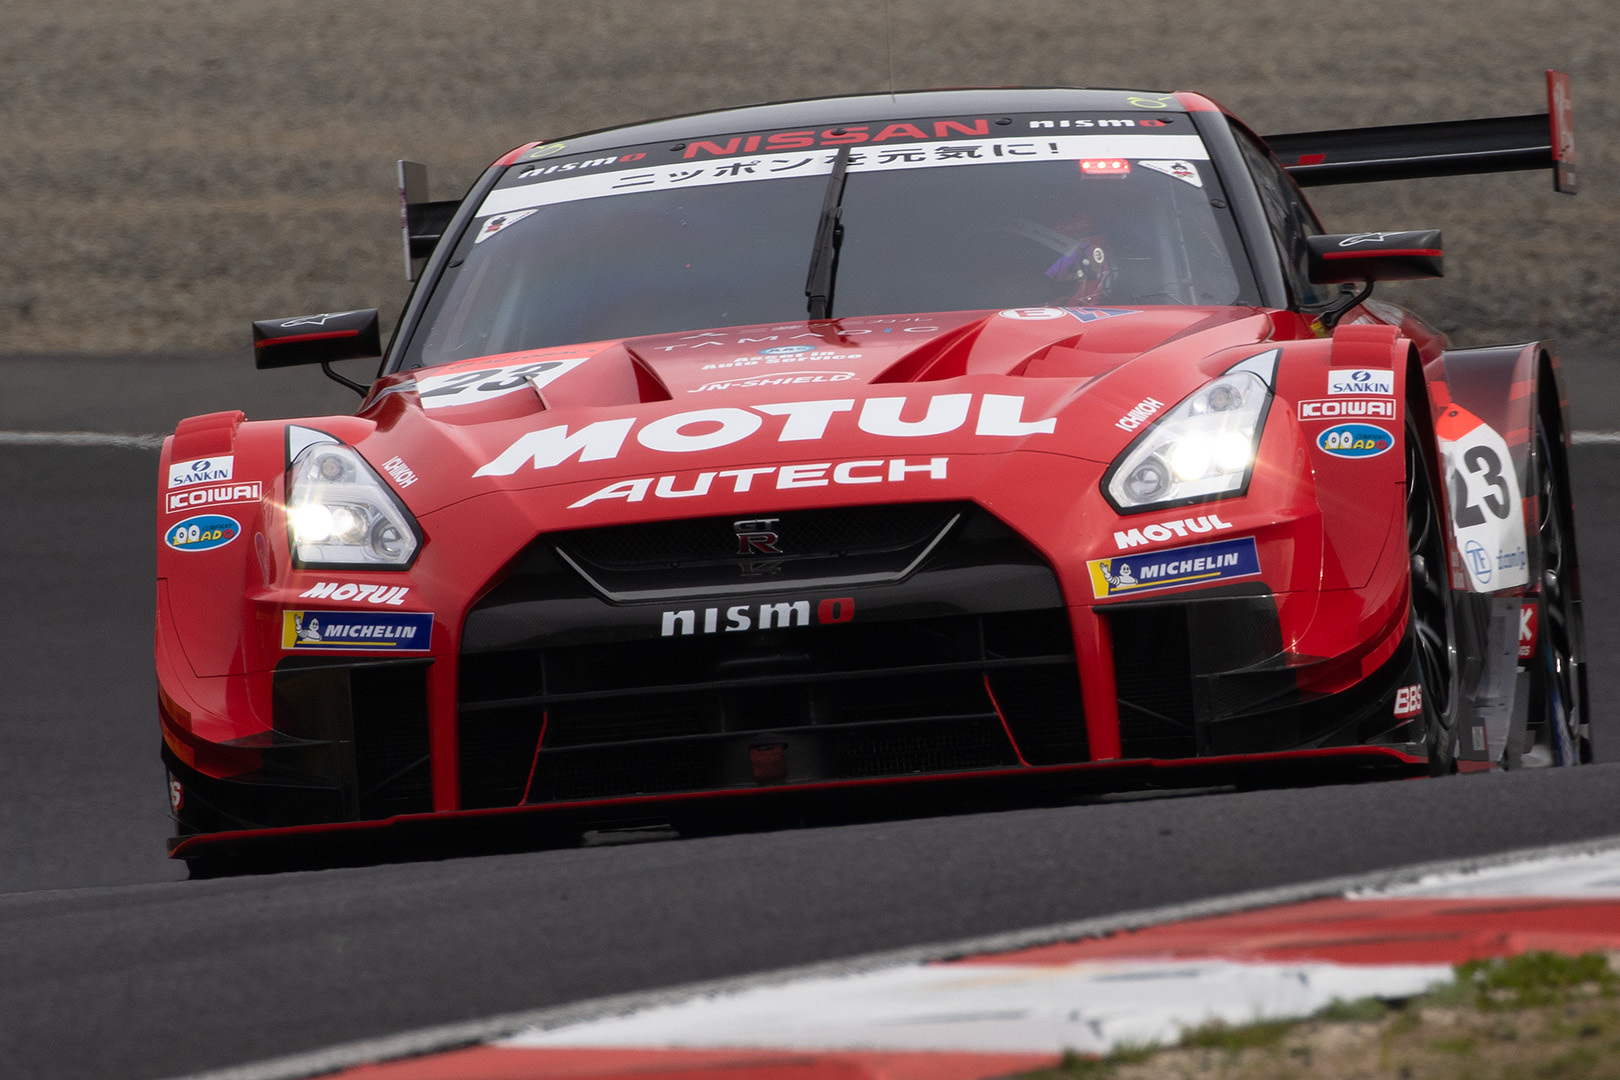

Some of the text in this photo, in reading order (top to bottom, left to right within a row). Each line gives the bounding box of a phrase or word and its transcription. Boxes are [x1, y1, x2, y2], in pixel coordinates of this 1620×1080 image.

[1029, 117, 1166, 129] nismo
[682, 119, 990, 160] NISSAN
[518, 152, 647, 179] nismo
[701, 360, 758, 371] Auto
[1333, 383, 1389, 393] SANKIN
[1115, 397, 1164, 432] ICHIKOH
[1302, 401, 1393, 417] KOIWAI
[471, 394, 1057, 479] MOTUL
[173, 469, 229, 486] SANKIN
[381, 455, 419, 489] ICHIKOH
[567, 457, 949, 509] AUTECH
[170, 484, 259, 510] KOIWAI
[1451, 445, 1511, 529] 23
[1113, 514, 1233, 550] MOTUL
[1140, 552, 1239, 580] MICHELIN
[299, 582, 409, 606] MOTUL
[661, 596, 856, 637] nismo
[324, 624, 418, 639] MICHELIN
[1394, 684, 1422, 715] BBS
